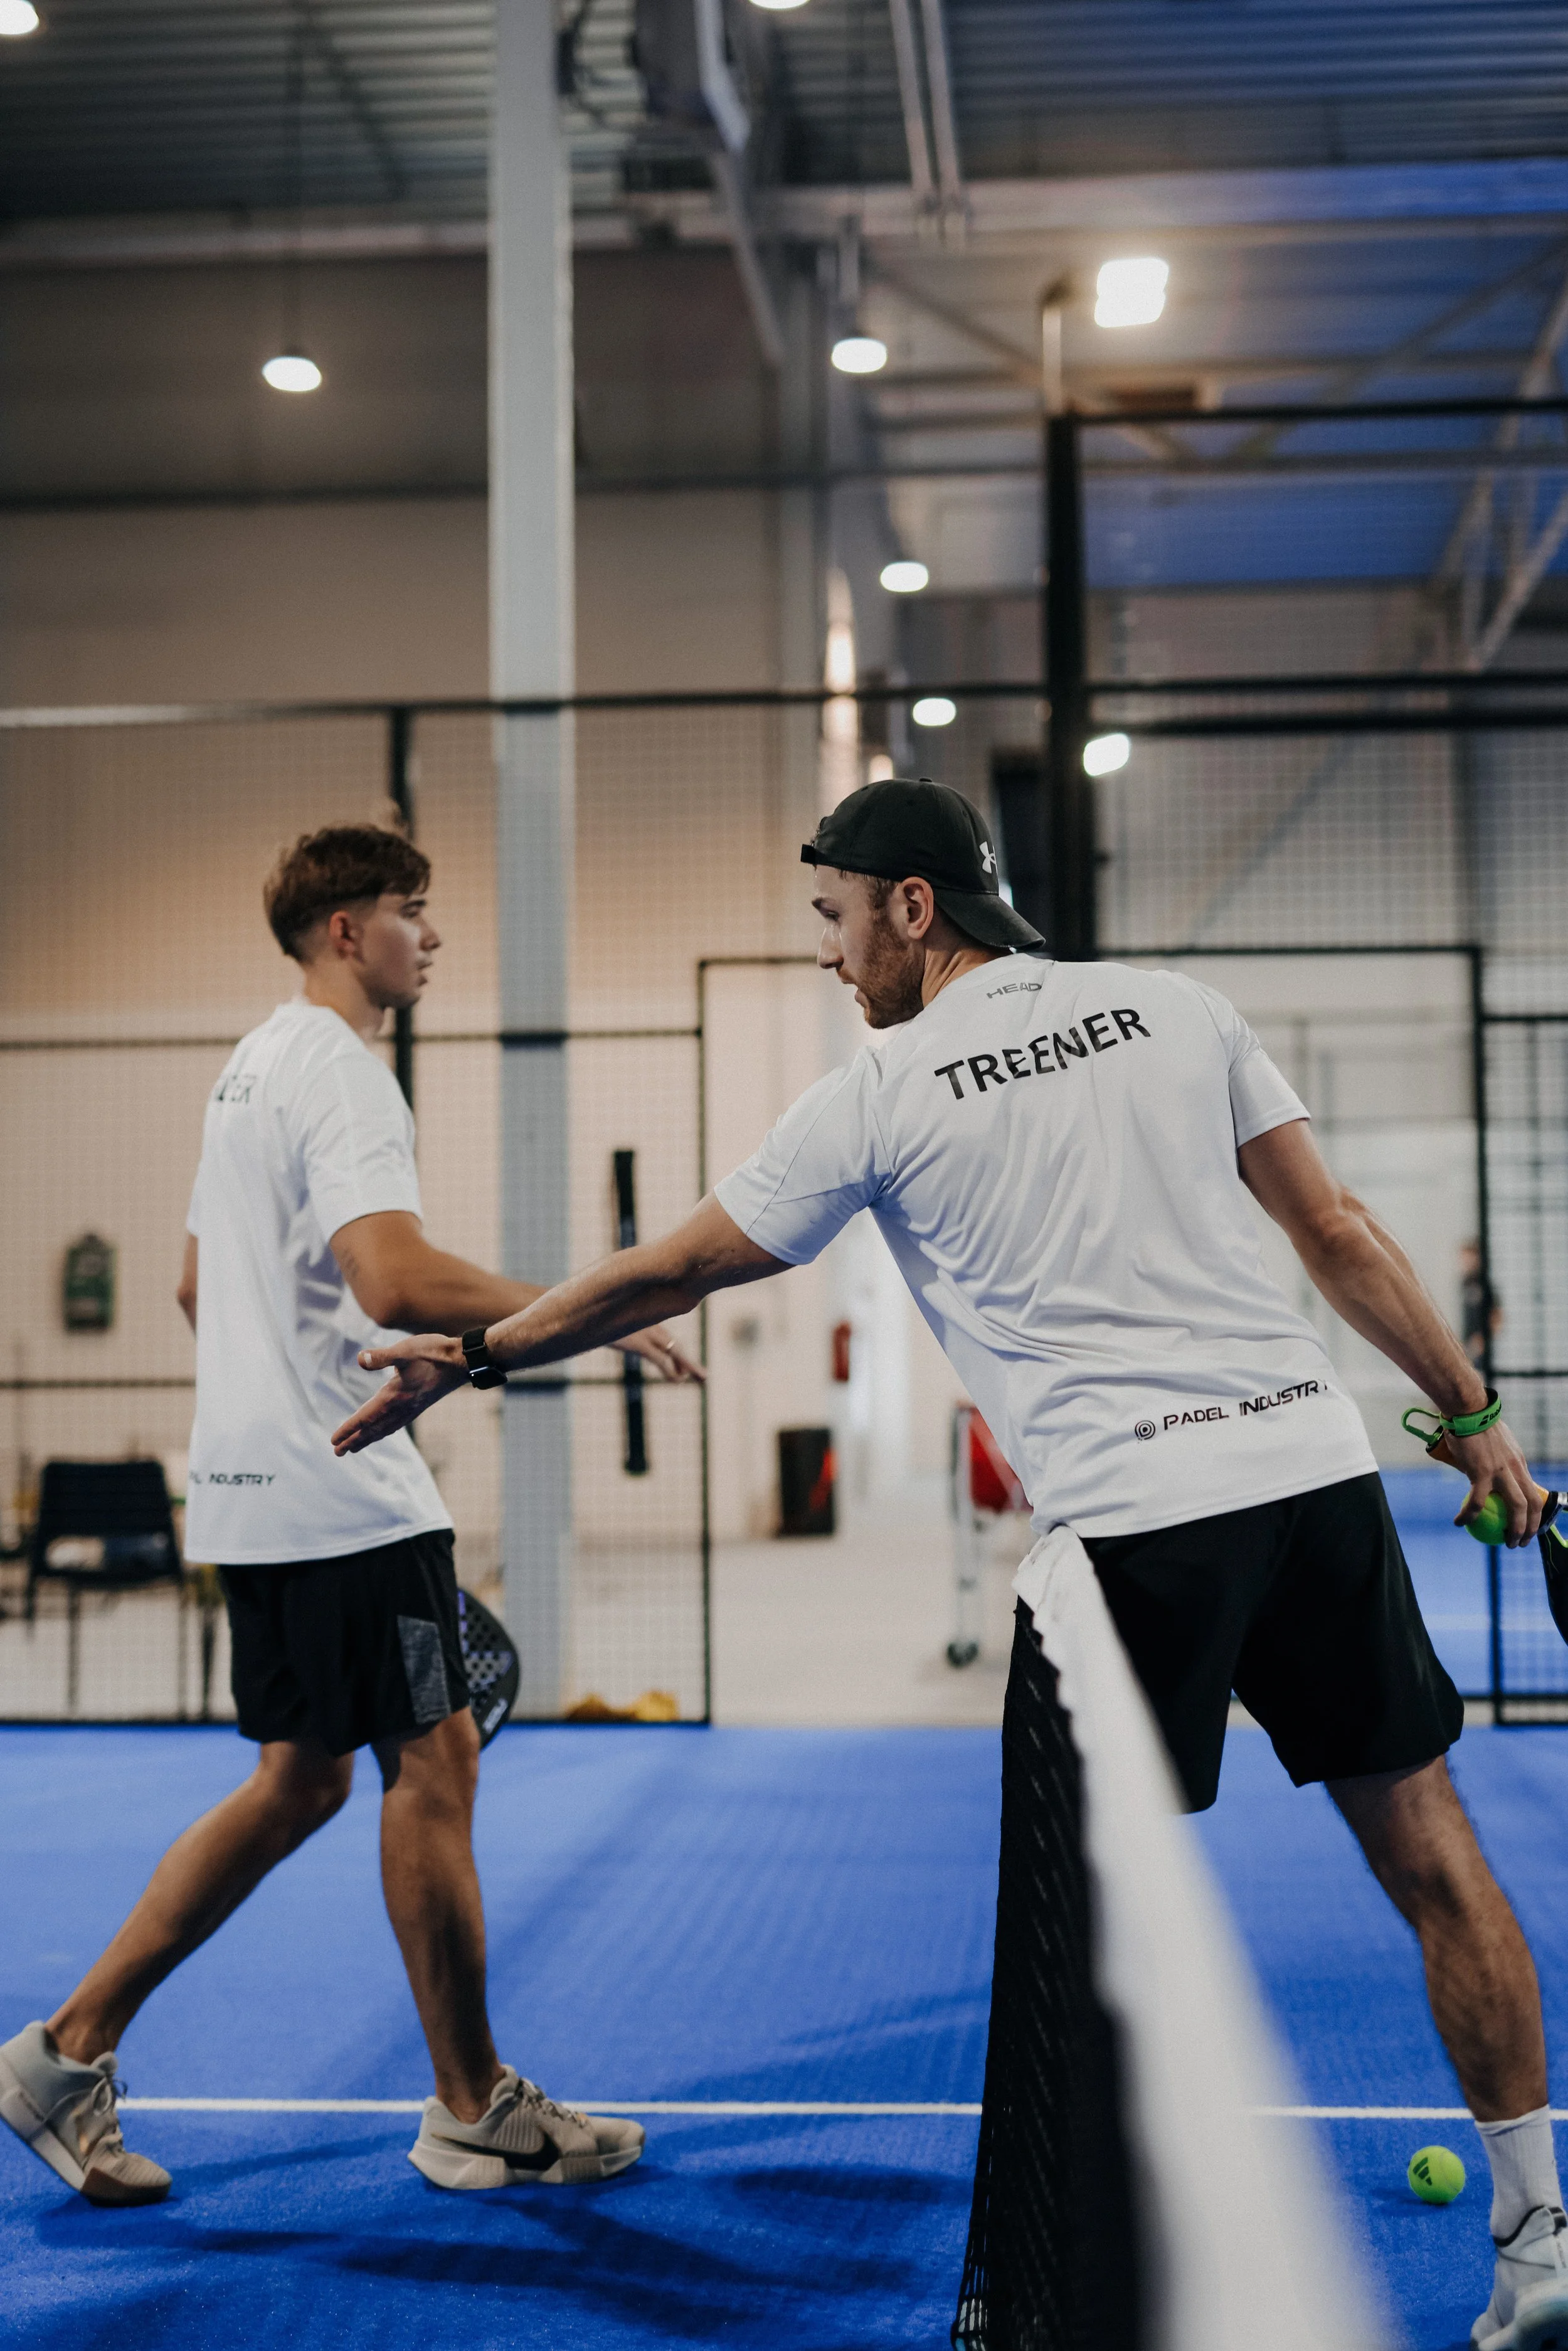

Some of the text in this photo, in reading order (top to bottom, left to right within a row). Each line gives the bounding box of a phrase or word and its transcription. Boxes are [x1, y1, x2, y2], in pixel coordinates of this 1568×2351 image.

[986, 982, 1042, 999] HEAD
[934, 1008, 1152, 1100] TREENER
[1163, 1406, 1230, 1431] PADEL
